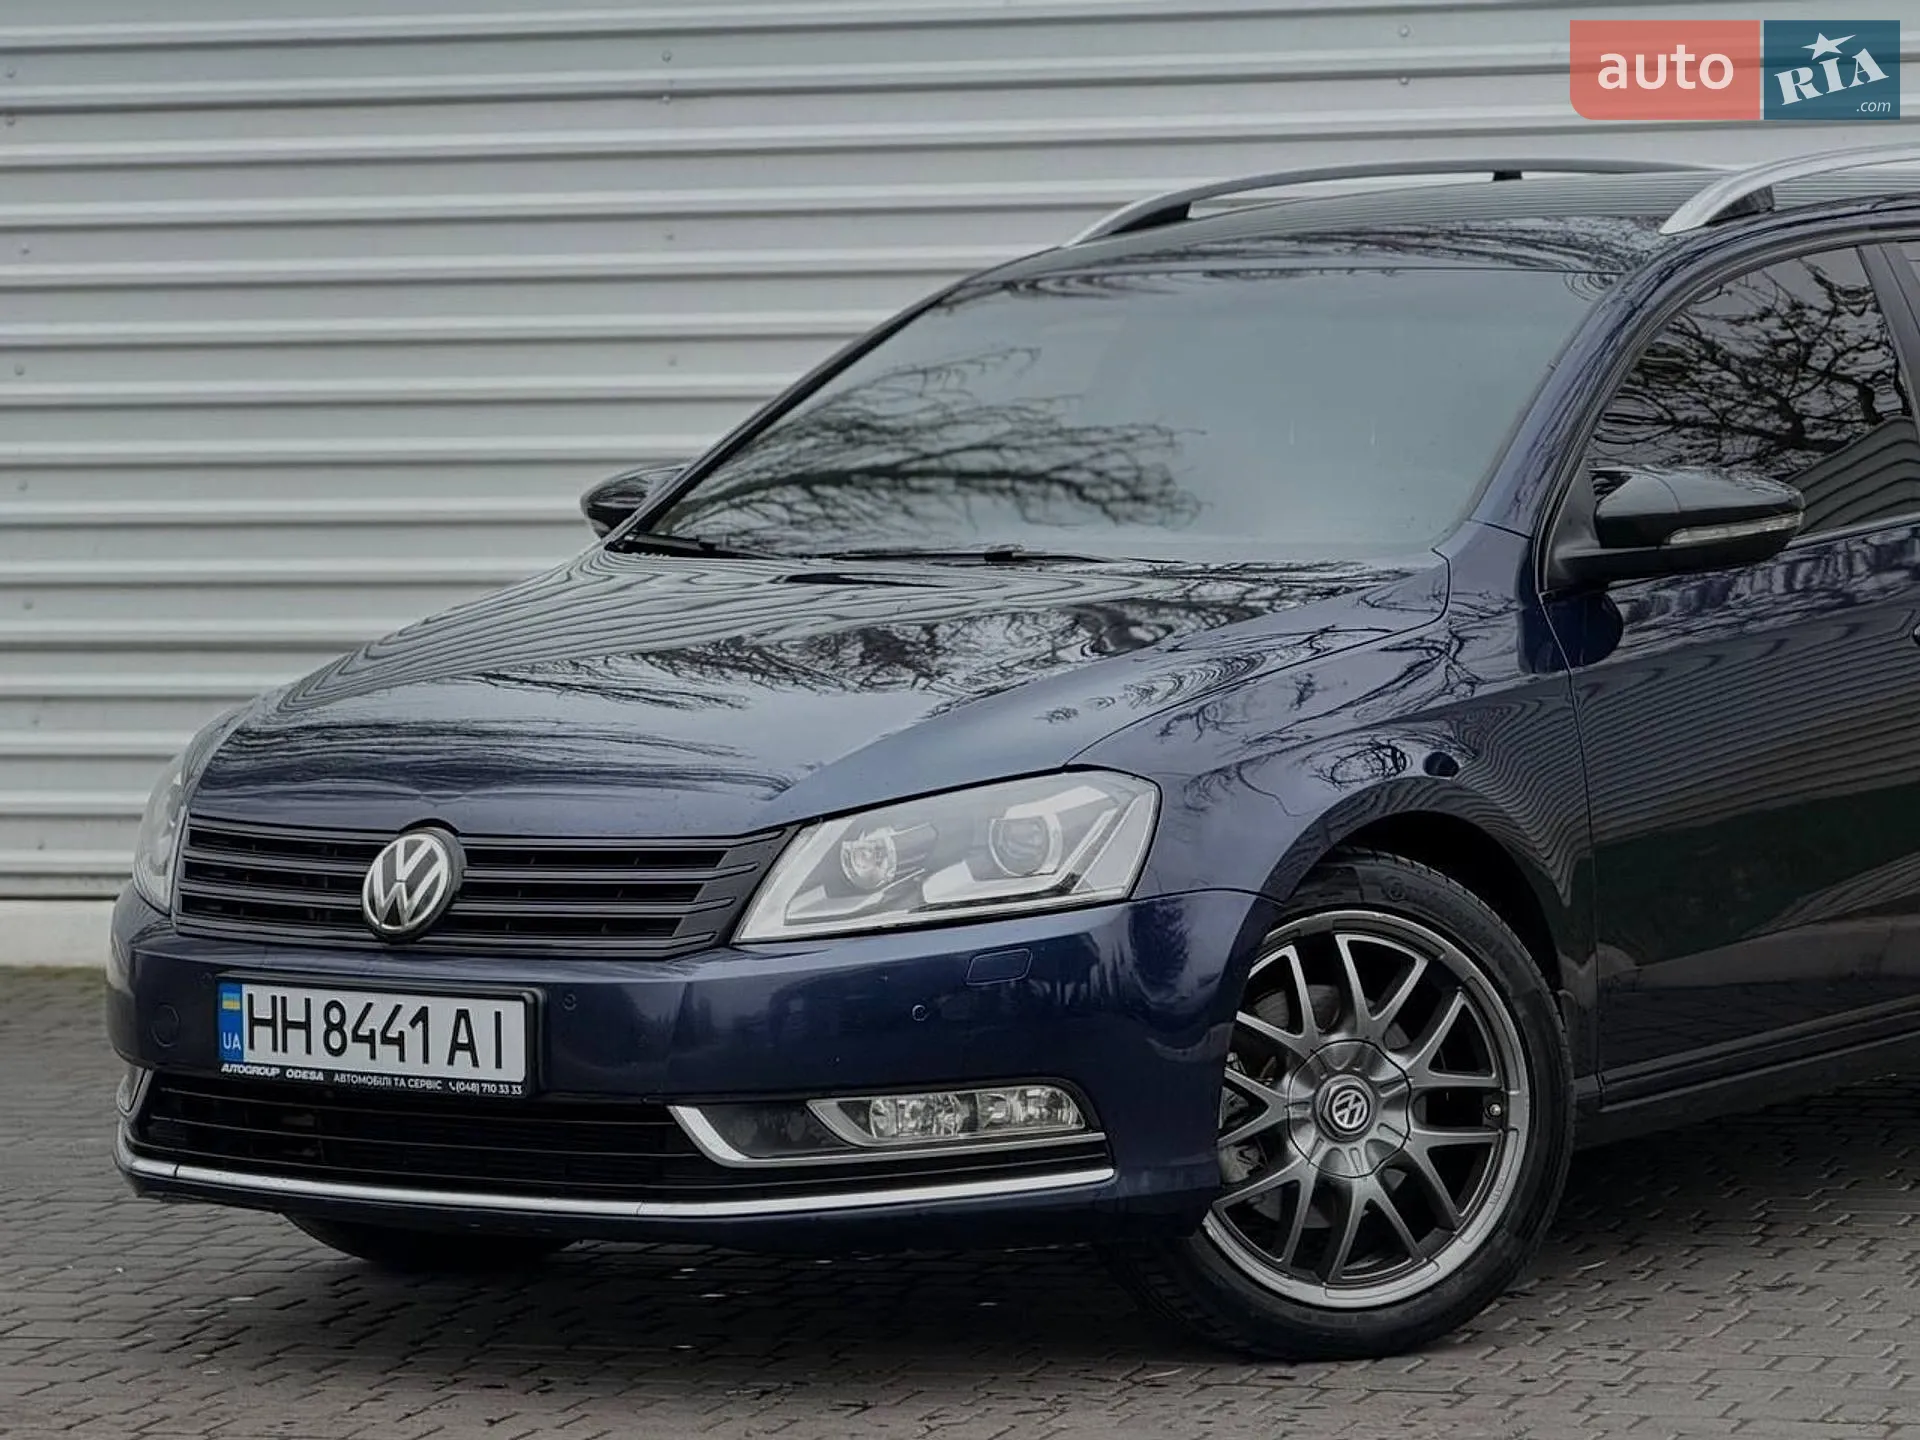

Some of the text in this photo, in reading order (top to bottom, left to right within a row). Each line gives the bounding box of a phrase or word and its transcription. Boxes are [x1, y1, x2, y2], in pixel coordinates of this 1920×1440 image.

[247, 992, 503, 1069] HH 8441 AI
[222, 1031, 242, 1051] UA
[221, 1063, 324, 1081] AUTOGROUP ODESA
[333, 1073, 442, 1090] АВТОМОБІЛІ ТА СЕРВІС
[481, 1083, 497, 1094] 710
[498, 1084, 510, 1094] 33
